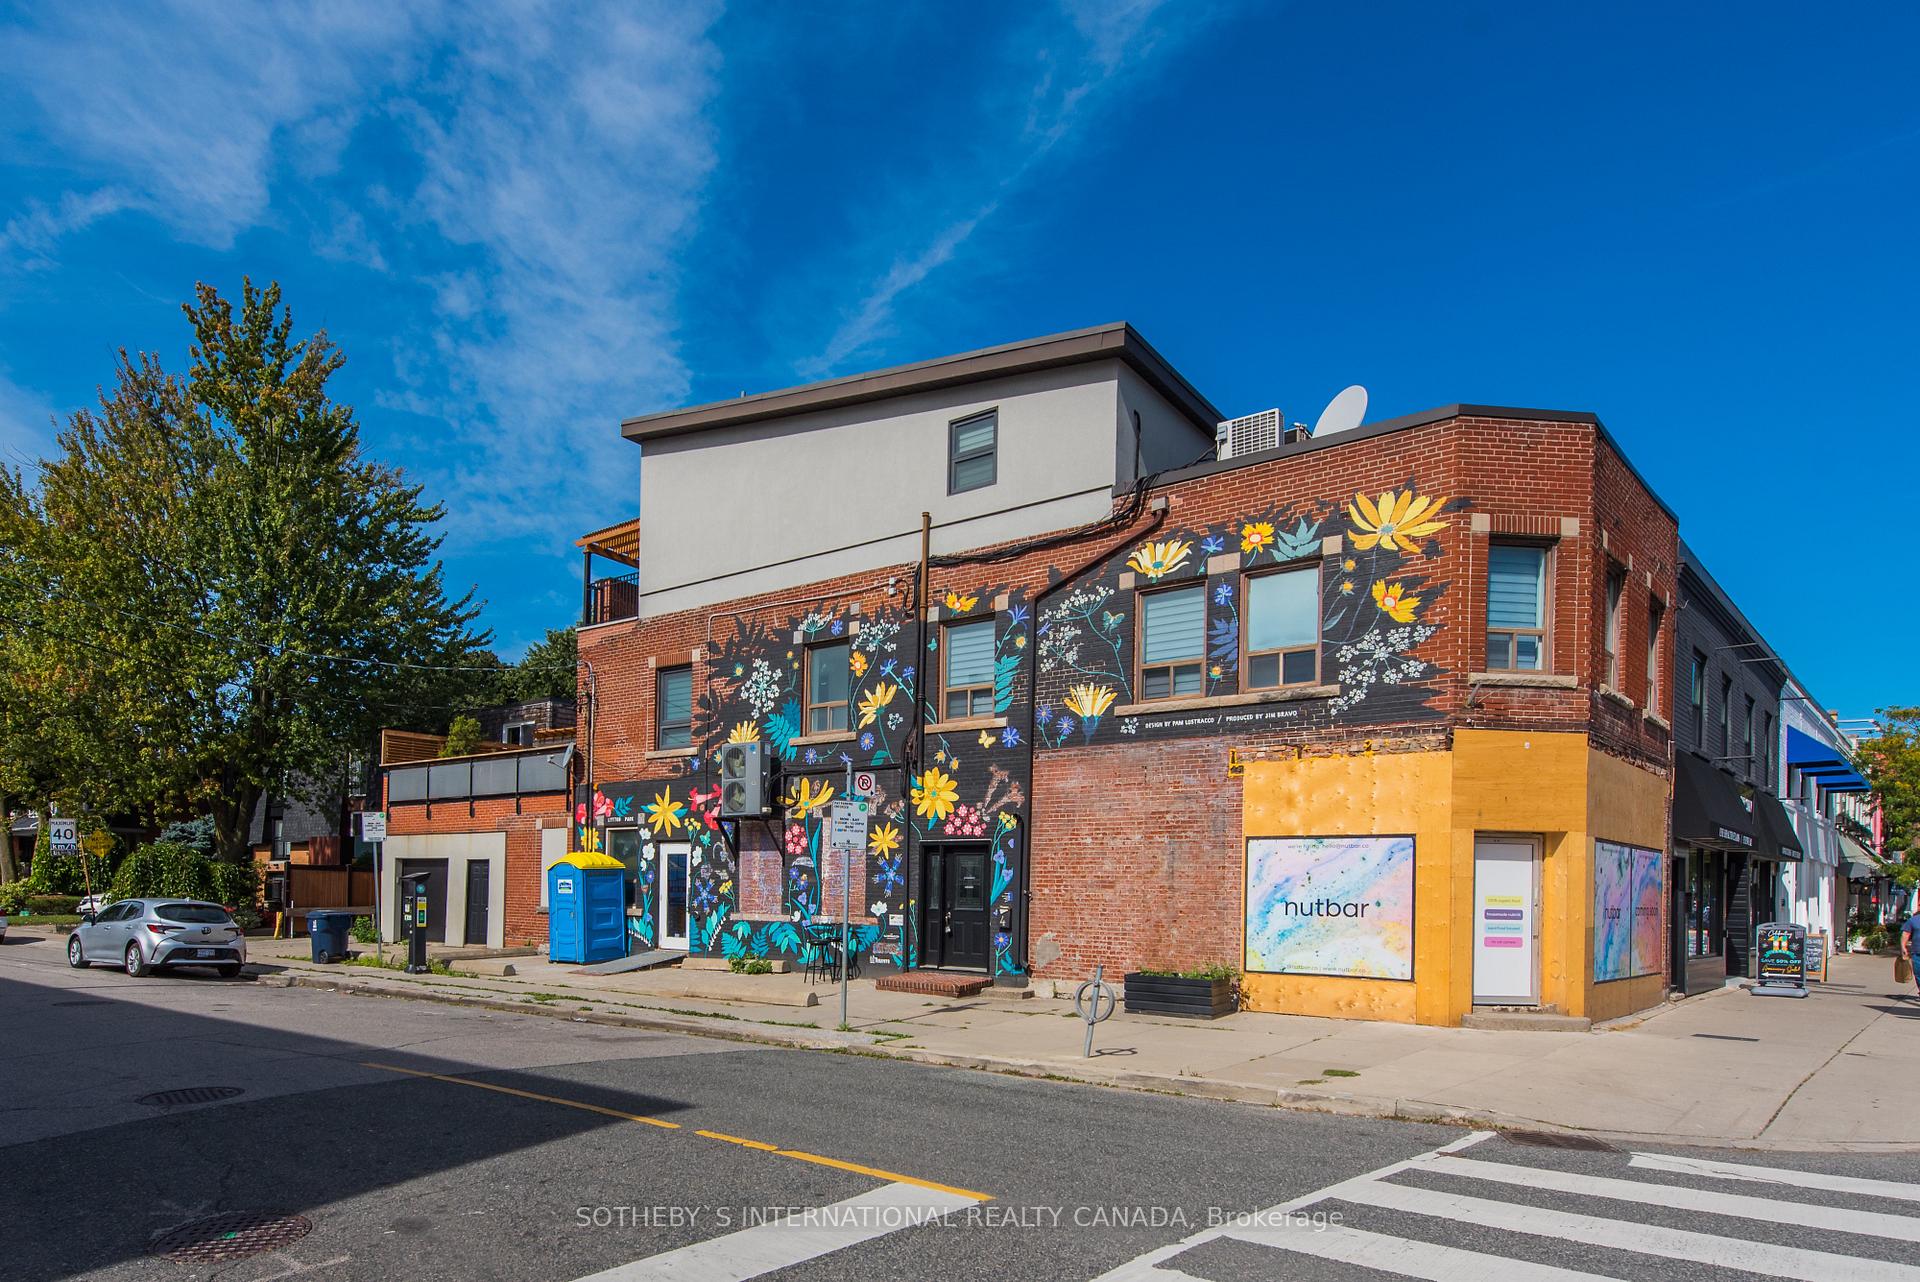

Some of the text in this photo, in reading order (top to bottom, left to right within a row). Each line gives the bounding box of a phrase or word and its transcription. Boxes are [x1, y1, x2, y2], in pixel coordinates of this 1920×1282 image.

[1145, 721, 1163, 729] DESIGN
[1226, 714, 1254, 722] PRODUCED
[1277, 710, 1298, 718] BRAVO
[53, 828, 74, 840] 40
[1284, 898, 1370, 918] nutbar
